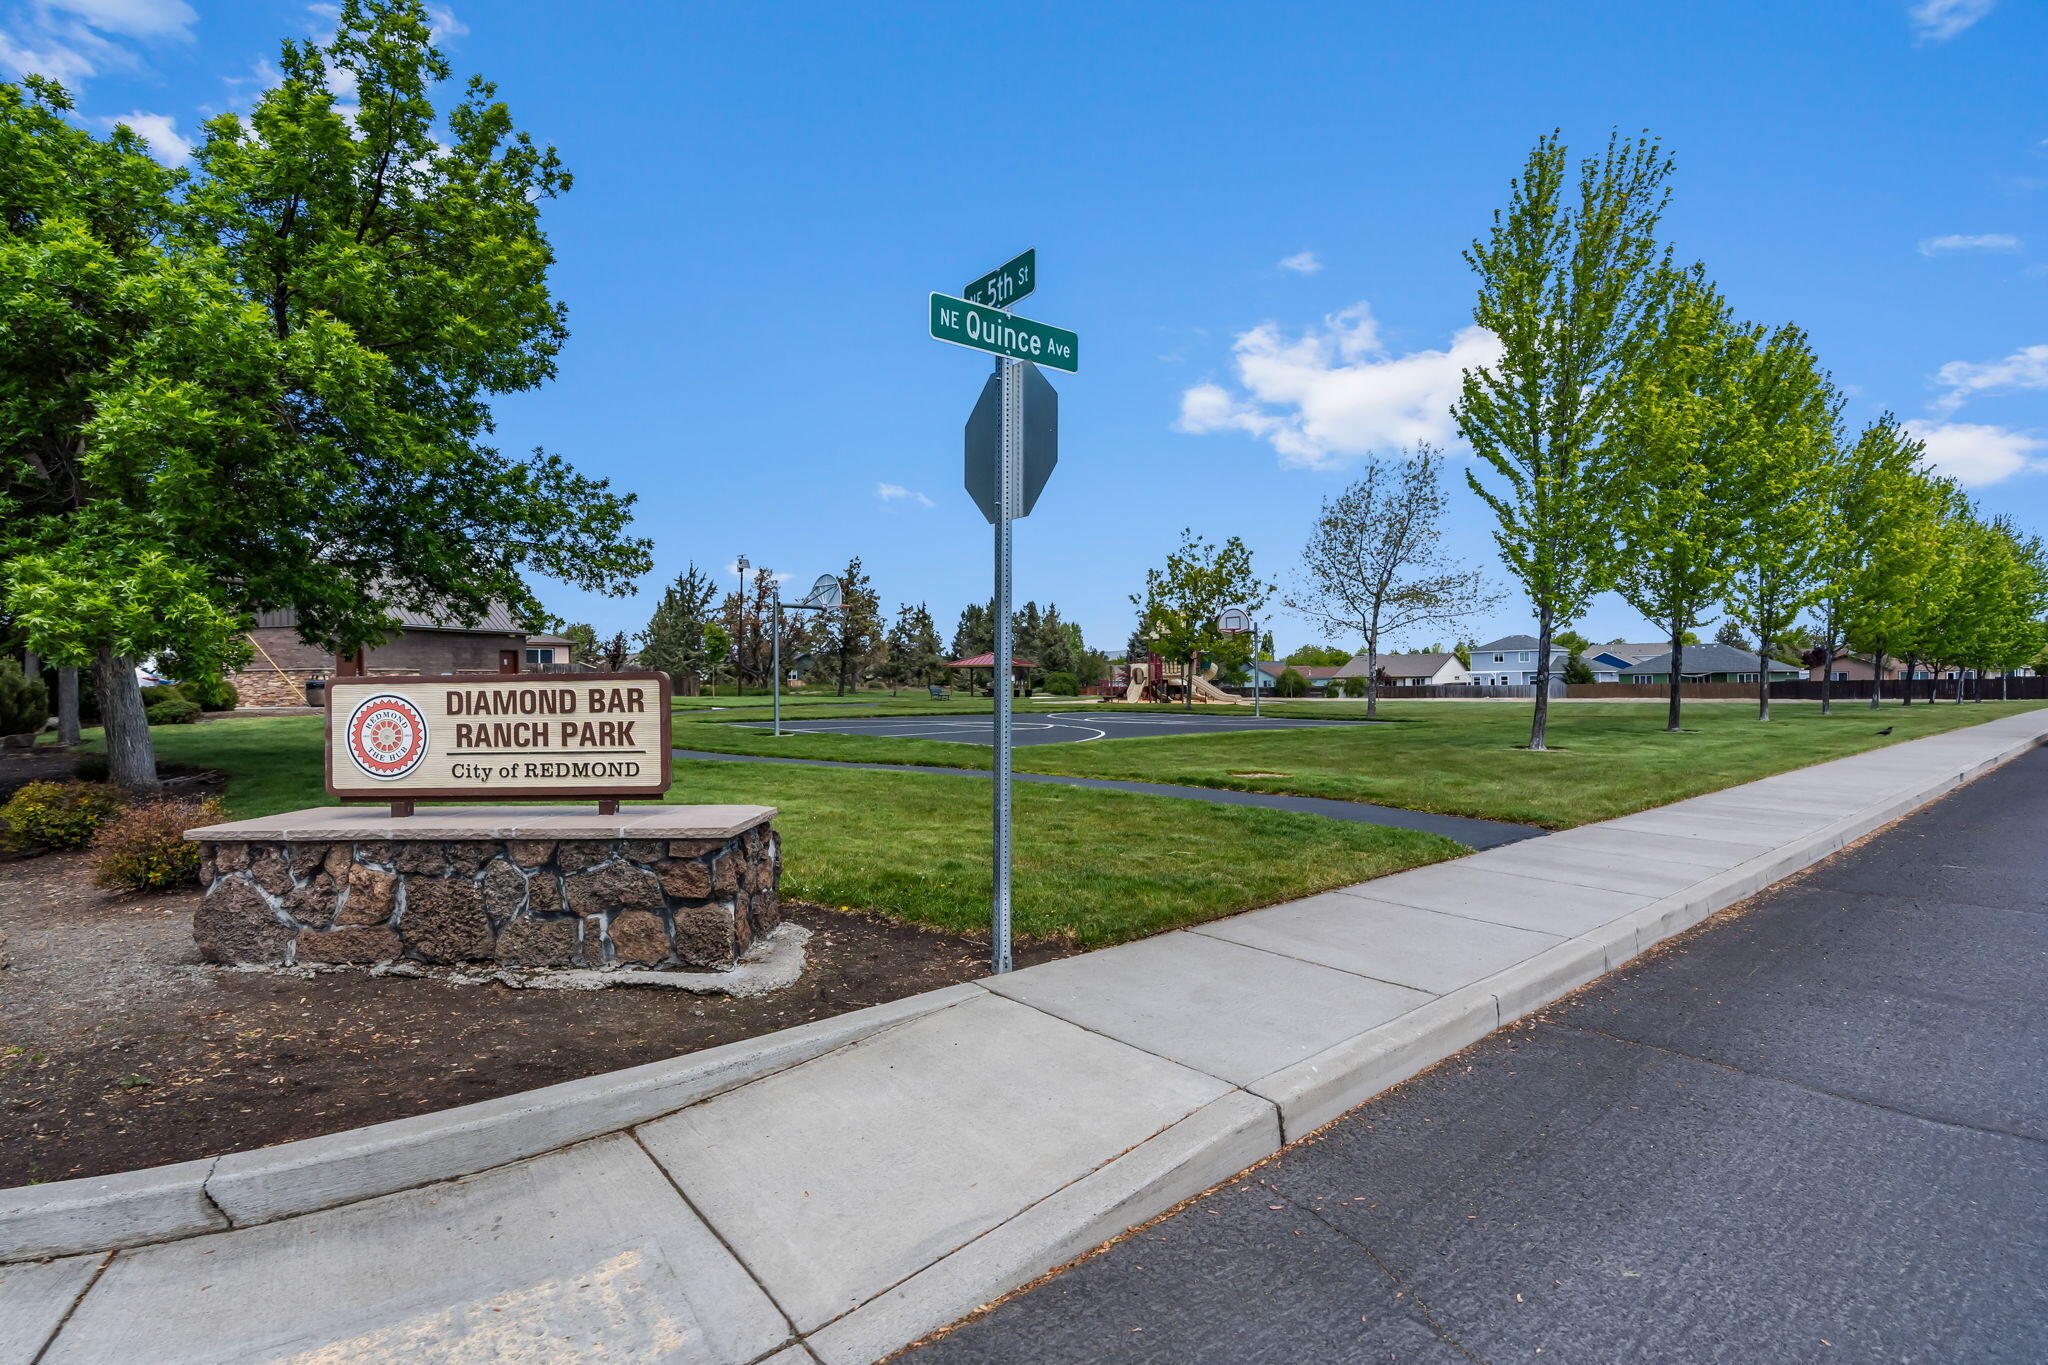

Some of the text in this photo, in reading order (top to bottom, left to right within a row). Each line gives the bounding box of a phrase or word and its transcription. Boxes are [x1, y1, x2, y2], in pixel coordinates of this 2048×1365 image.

[988, 271, 1013, 307] 5th
[1018, 265, 1029, 285] St
[940, 308, 1070, 358] NE Quince Ave
[446, 688, 645, 715] DIAMOND BAR
[365, 711, 408, 730] REDMOND
[456, 720, 636, 748] RANCH PARK
[368, 746, 408, 761] THE HUB
[451, 762, 640, 782] City of REDMOND
